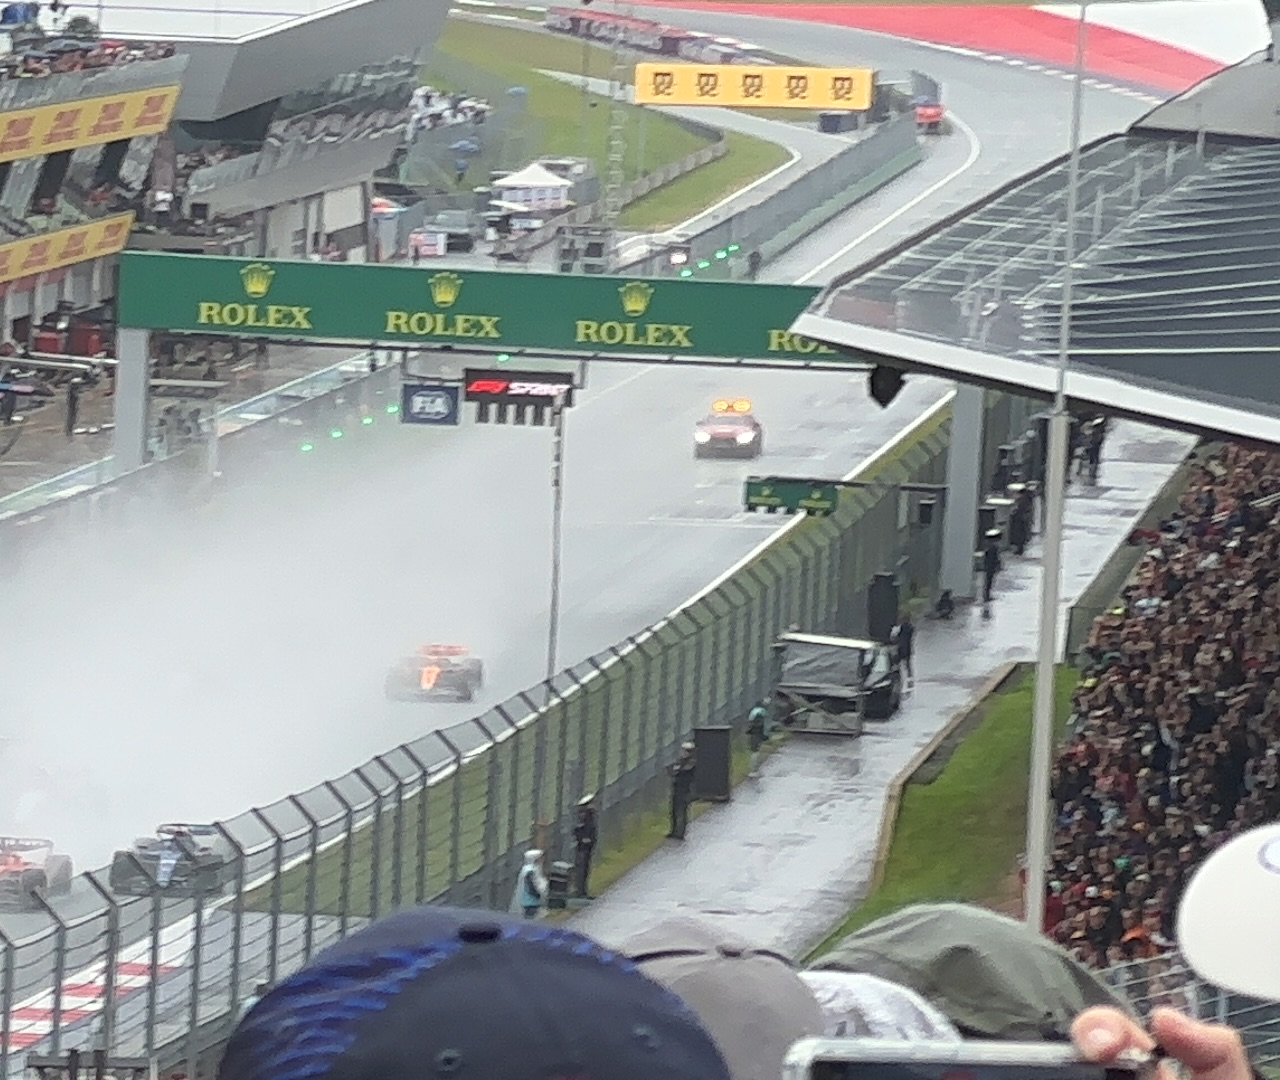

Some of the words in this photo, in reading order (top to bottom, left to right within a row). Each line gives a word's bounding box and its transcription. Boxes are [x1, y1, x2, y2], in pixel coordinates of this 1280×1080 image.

[198, 302, 312, 331] ROLEX
[385, 311, 500, 340] ROLEX
[575, 320, 692, 348] ROLEX
